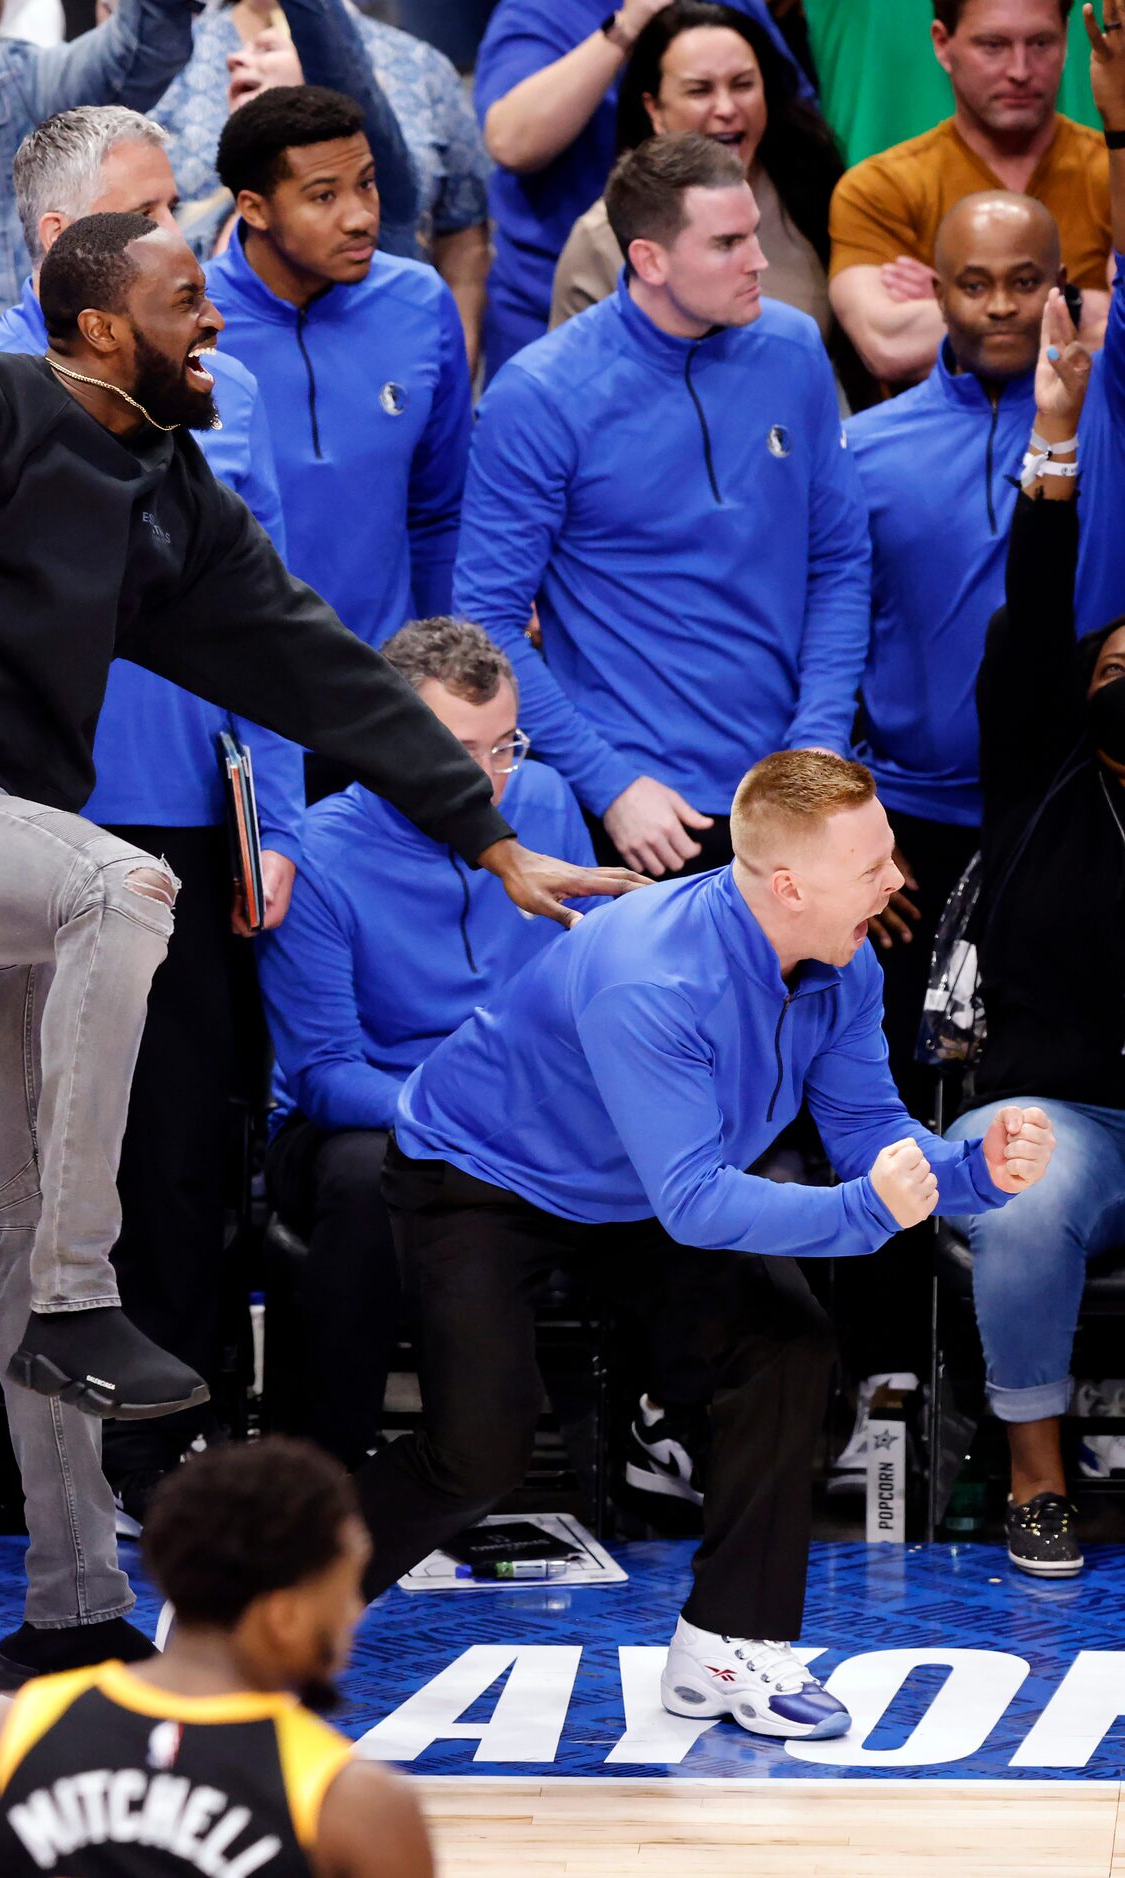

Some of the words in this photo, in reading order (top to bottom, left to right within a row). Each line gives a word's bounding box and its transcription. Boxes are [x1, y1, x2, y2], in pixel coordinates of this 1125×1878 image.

[878, 1461, 895, 1531] POPCORN
[350, 1615, 559, 1663] JACKSON
[889, 1599, 1088, 1642] DORIAN
